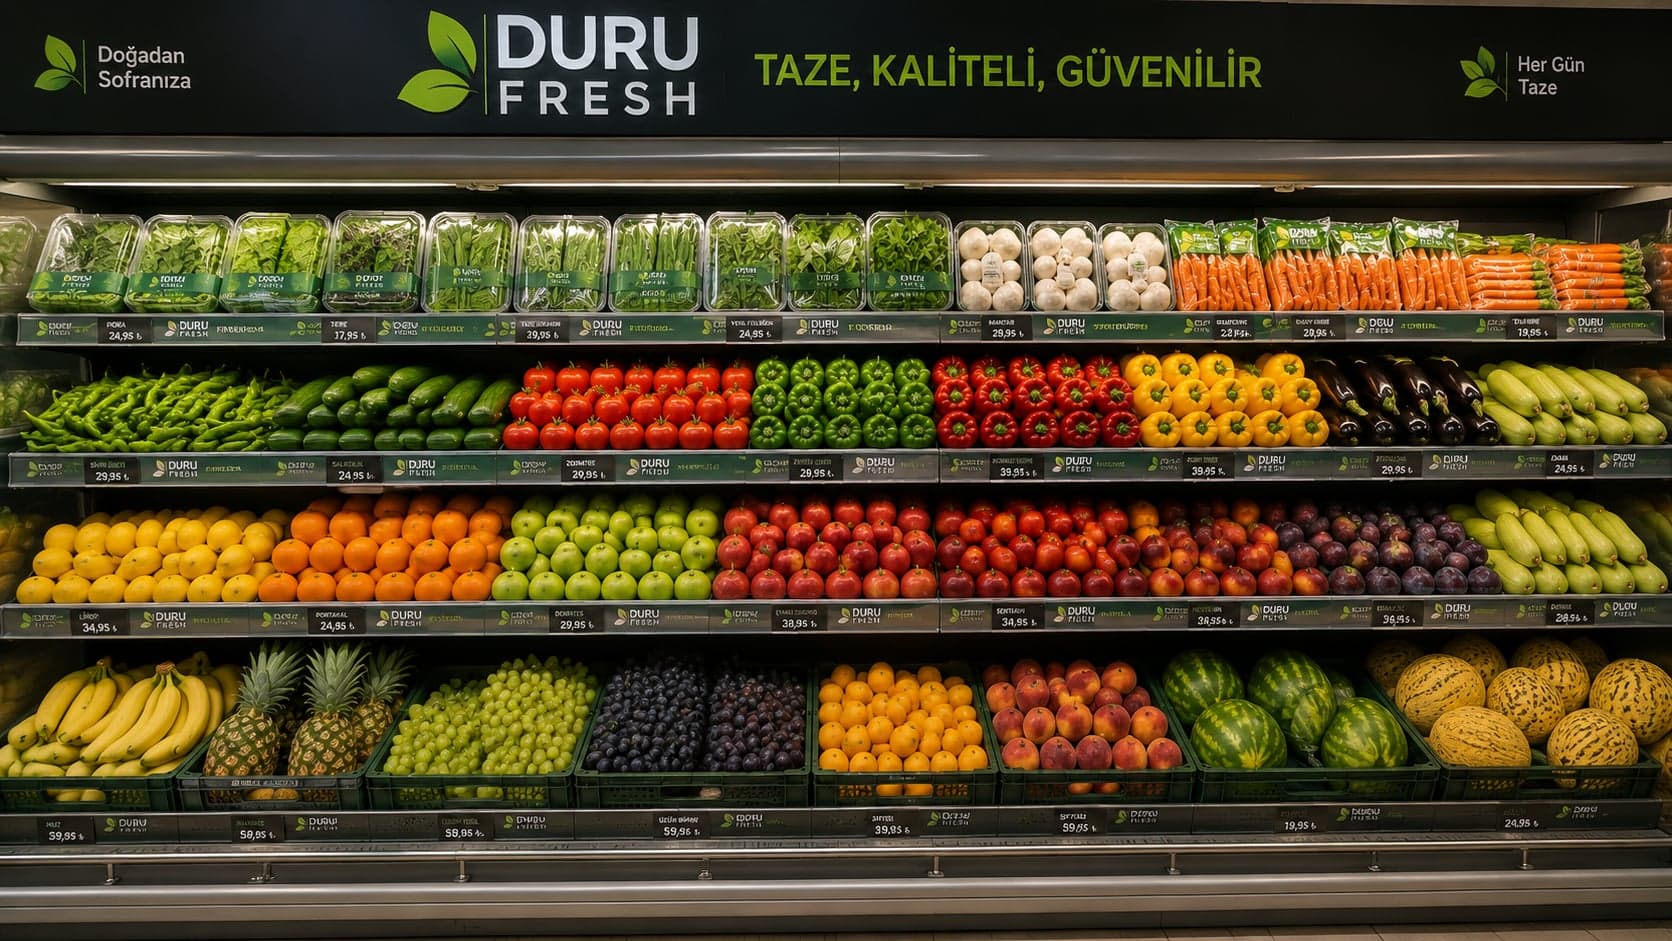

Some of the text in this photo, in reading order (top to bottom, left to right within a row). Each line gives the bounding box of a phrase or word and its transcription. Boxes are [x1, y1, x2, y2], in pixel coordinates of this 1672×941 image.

[497, 15, 699, 71] DURU
[98, 46, 185, 68] Doğadan
[754, 46, 1262, 92] TAZE, KALİTELİ, GÜVENİLİR
[1518, 56, 1585, 73] Her Gün
[98, 70, 192, 89] Sofranıza
[1518, 78, 1558, 95] Taze
[499, 80, 696, 116] FRESH
[179, 321, 209, 330] DURU
[593, 320, 622, 329] DURU
[811, 320, 839, 329] DURU
[1058, 319, 1085, 328] DURU
[108, 331, 134, 341] 24,95
[738, 330, 764, 340] 24,95
[168, 461, 198, 470] DURU
[641, 459, 670, 468] DURU
[95, 471, 122, 482] 29,95
[155, 611, 186, 621] DURU
[391, 610, 422, 620] DURU
[630, 609, 660, 618] DURU
[852, 608, 881, 617] DURU
[1068, 607, 1095, 616] DURU
[82, 623, 110, 633] 34,95
[1284, 821, 1309, 831] 19,95
